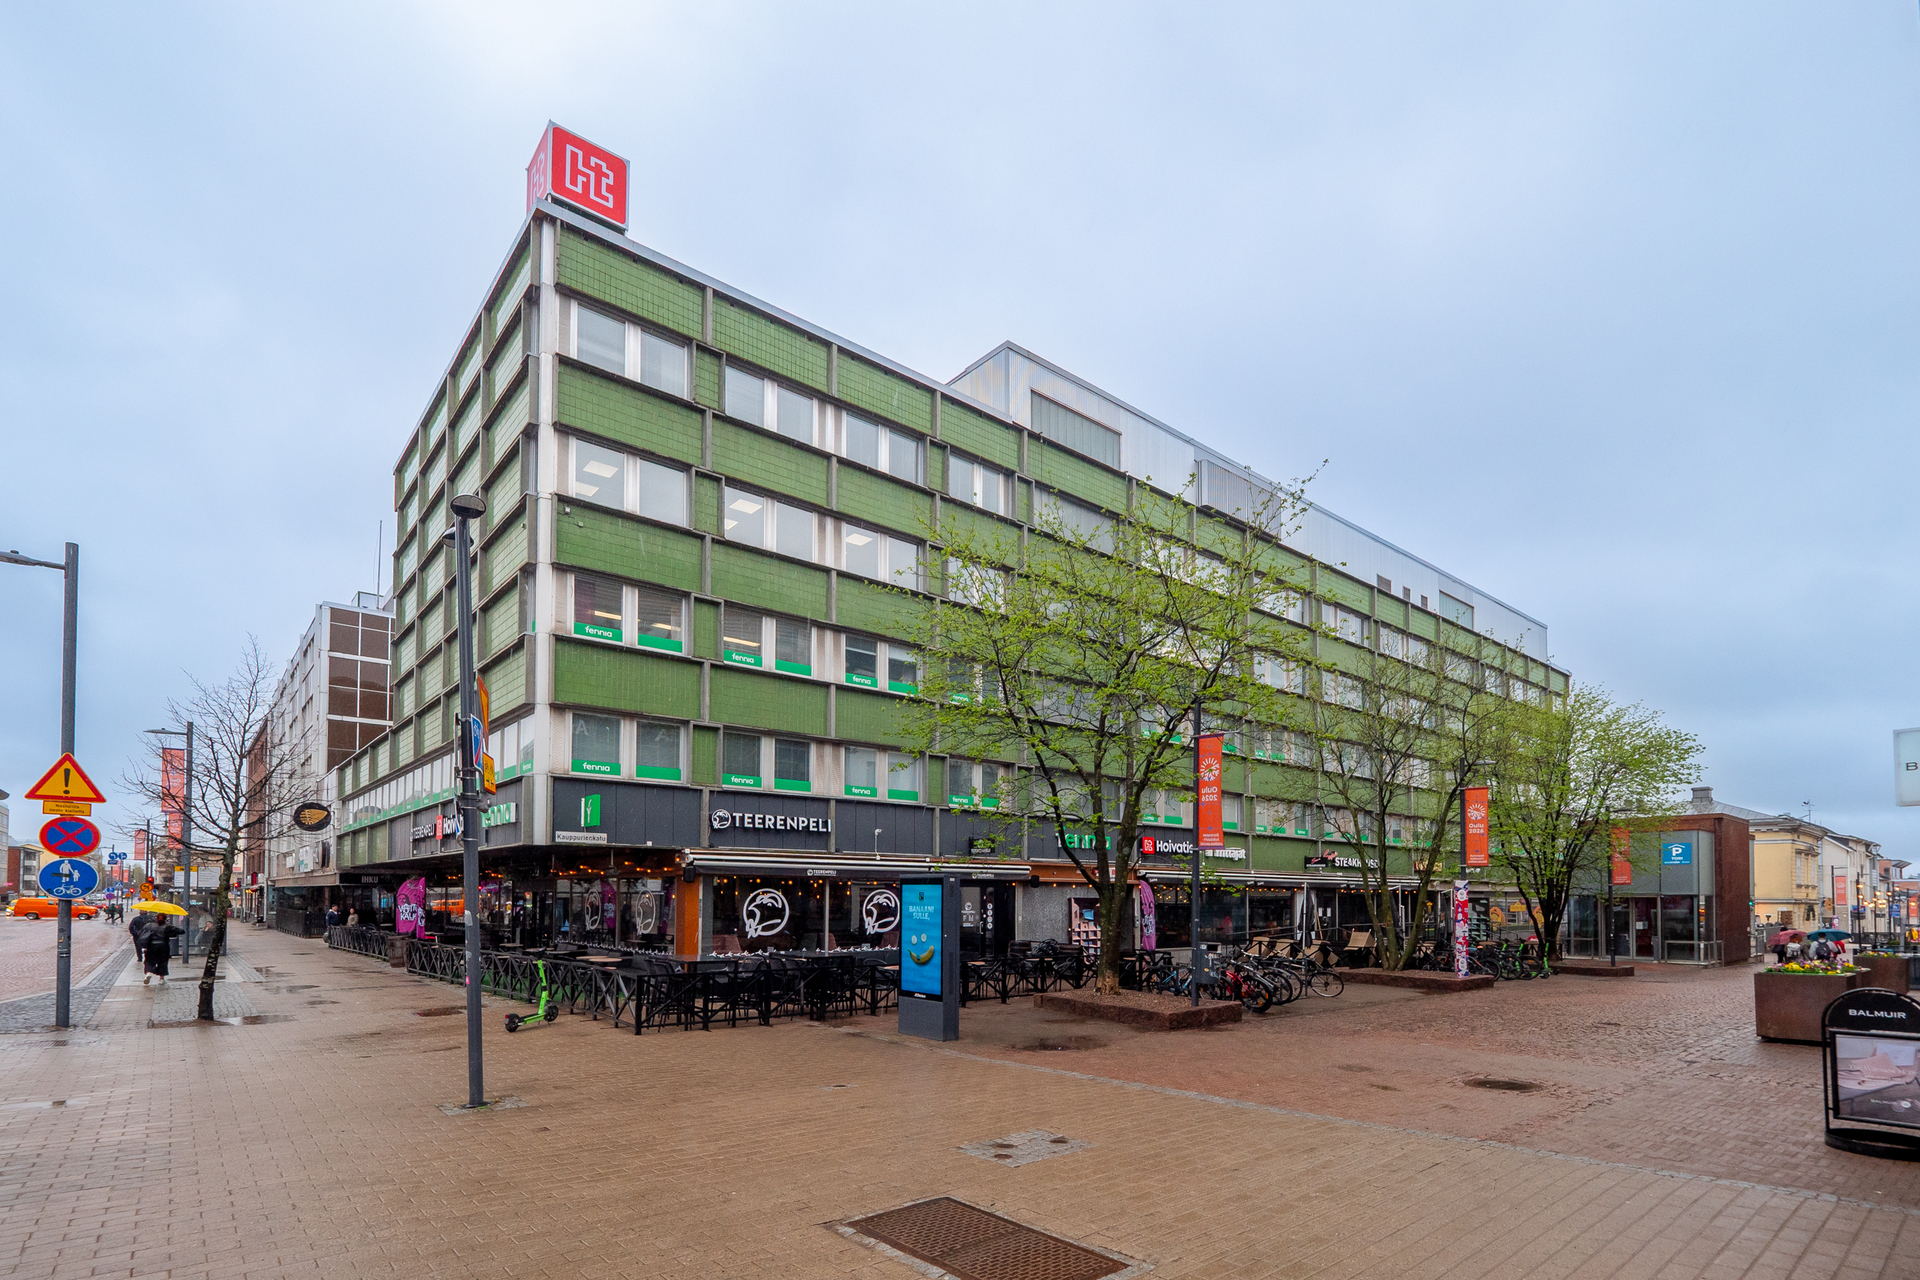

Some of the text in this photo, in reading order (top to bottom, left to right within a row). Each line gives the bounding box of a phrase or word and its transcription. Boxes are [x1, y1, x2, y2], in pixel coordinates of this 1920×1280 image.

[584, 625, 613, 638] fennia
[731, 653, 755, 664] fennia
[852, 675, 871, 685] fennia
[582, 761, 610, 772] fennia
[730, 775, 754, 785] fennia
[851, 787, 871, 796] fennia
[733, 812, 832, 833] TEERENPELI
[557, 833, 606, 842] Kauppurienkatu
[361, 875, 379, 883] IHKU
[1848, 1009, 1907, 1020] BALMUIR
